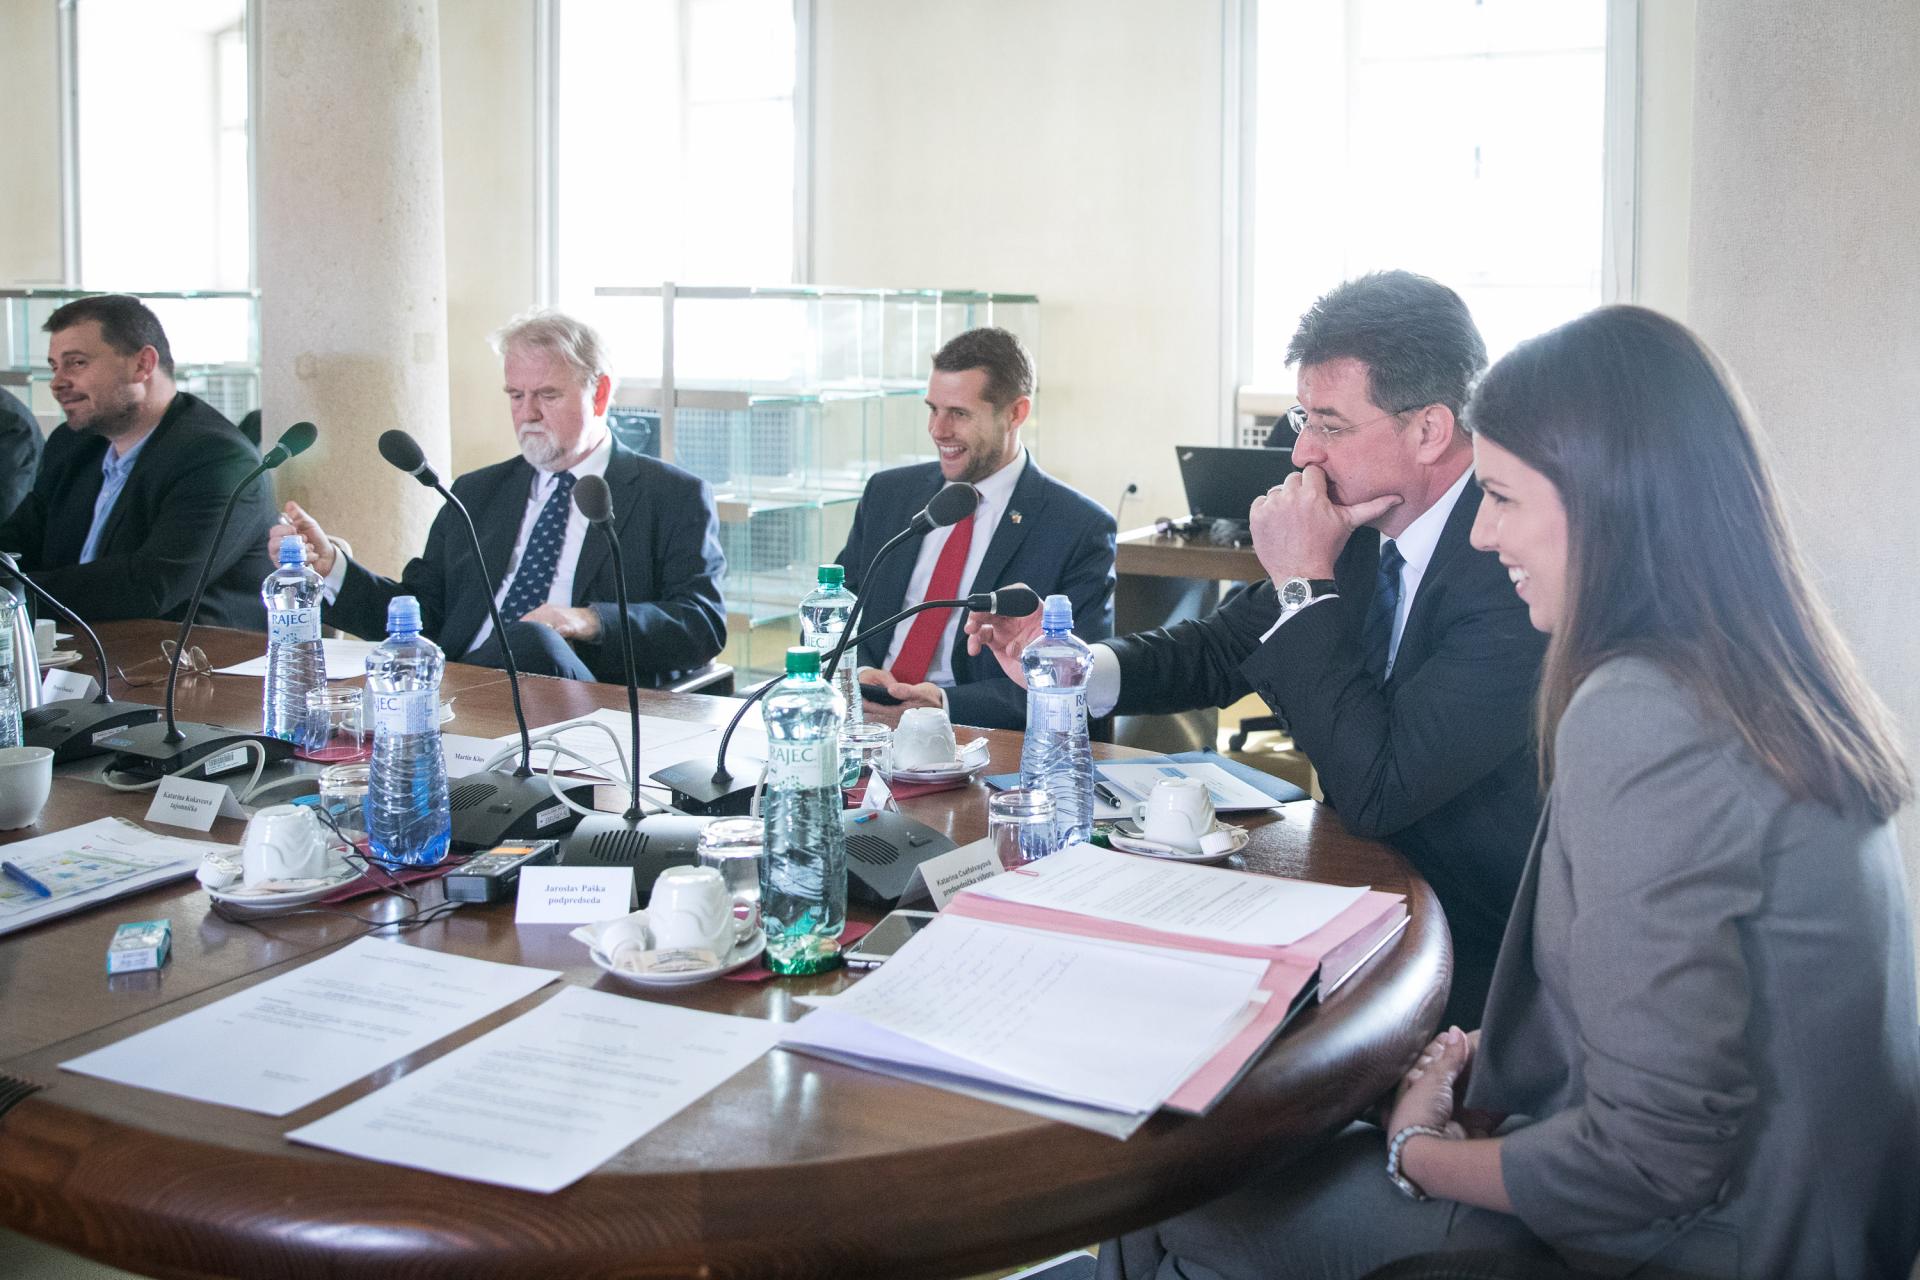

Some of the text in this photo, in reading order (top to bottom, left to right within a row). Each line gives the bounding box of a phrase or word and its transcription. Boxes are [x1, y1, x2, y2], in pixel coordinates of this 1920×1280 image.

[272, 613, 308, 627] RAJEC
[375, 697, 399, 712] JEC
[769, 745, 816, 765] RAJEC
[543, 884, 579, 893] Jaroslav
[547, 895, 601, 906] podpredseda
